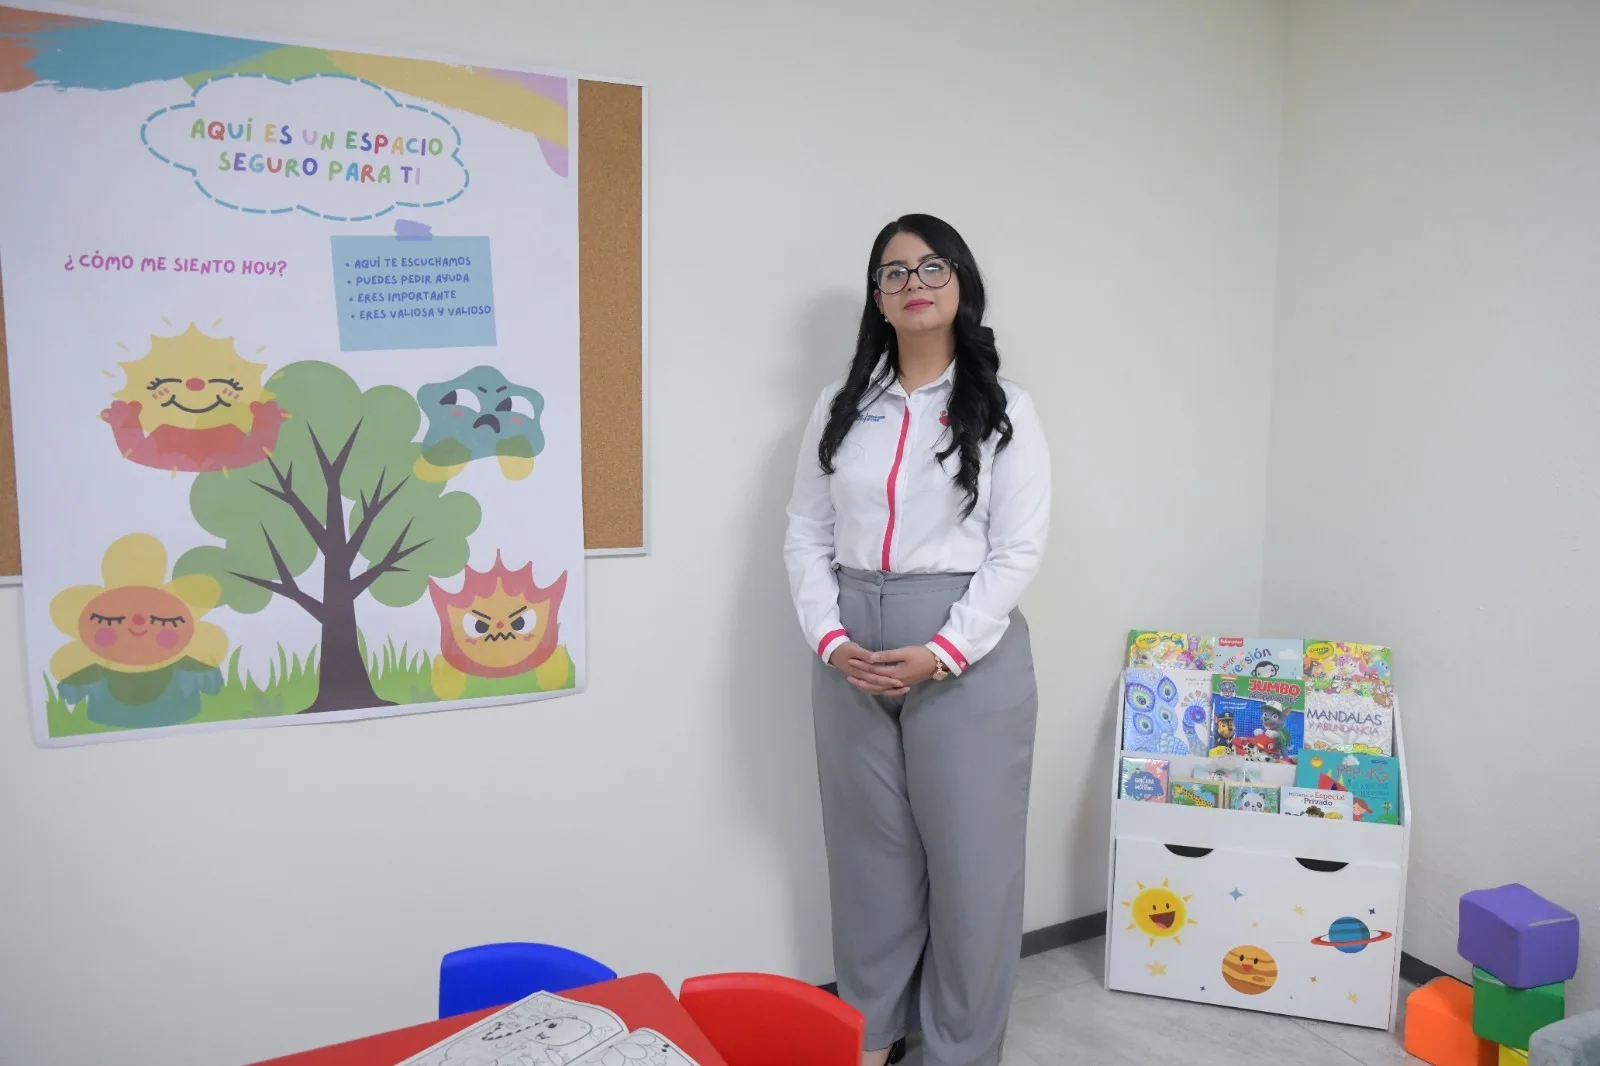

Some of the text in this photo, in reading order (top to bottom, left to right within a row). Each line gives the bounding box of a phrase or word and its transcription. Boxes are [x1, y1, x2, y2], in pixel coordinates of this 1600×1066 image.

[190, 117, 443, 156] AQUÍ ES UN ESPACIO
[218, 151, 421, 185] SEGURO PARA TI
[64, 250, 288, 277] ¿CÓMO ME SIENTO HOY?
[354, 255, 471, 269] AQUÍ TE ESCUCHAMOS
[356, 273, 470, 286] PUEDES PEDIR AYUDA
[357, 290, 457, 303] ERES IMPORTANTE
[360, 305, 491, 320] ERES VALIOSA Y VALIOSO
[1248, 679, 1301, 697] JUMBO
[1306, 708, 1383, 726] MANDALAS
[1317, 722, 1380, 736] ABUNDANCIA
[1303, 797, 1333, 806] Privado
[1314, 791, 1345, 801] Especial
